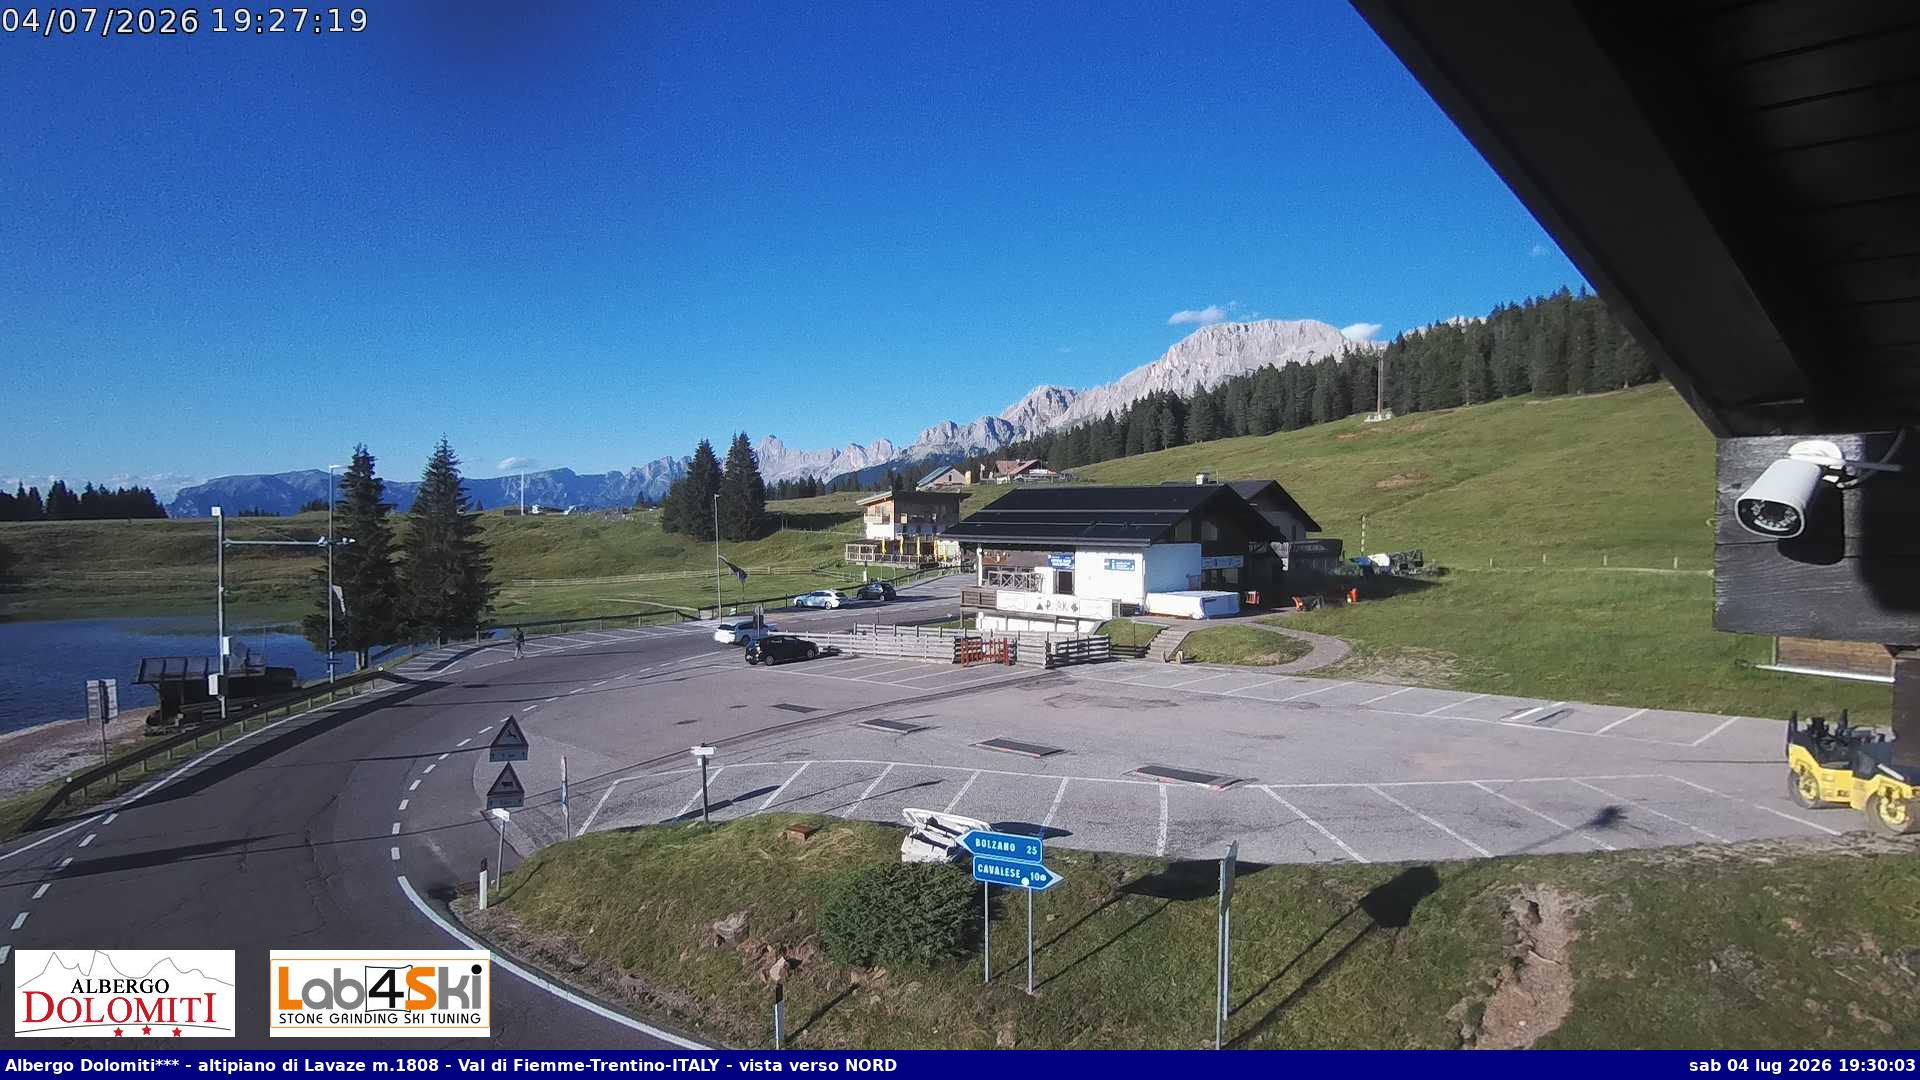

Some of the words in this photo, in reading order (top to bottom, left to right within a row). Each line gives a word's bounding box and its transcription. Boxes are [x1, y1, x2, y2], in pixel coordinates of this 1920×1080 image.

[975, 838, 1016, 852] BOLZANO
[1026, 845, 1038, 855] 25
[977, 863, 1021, 879] CAVALESE
